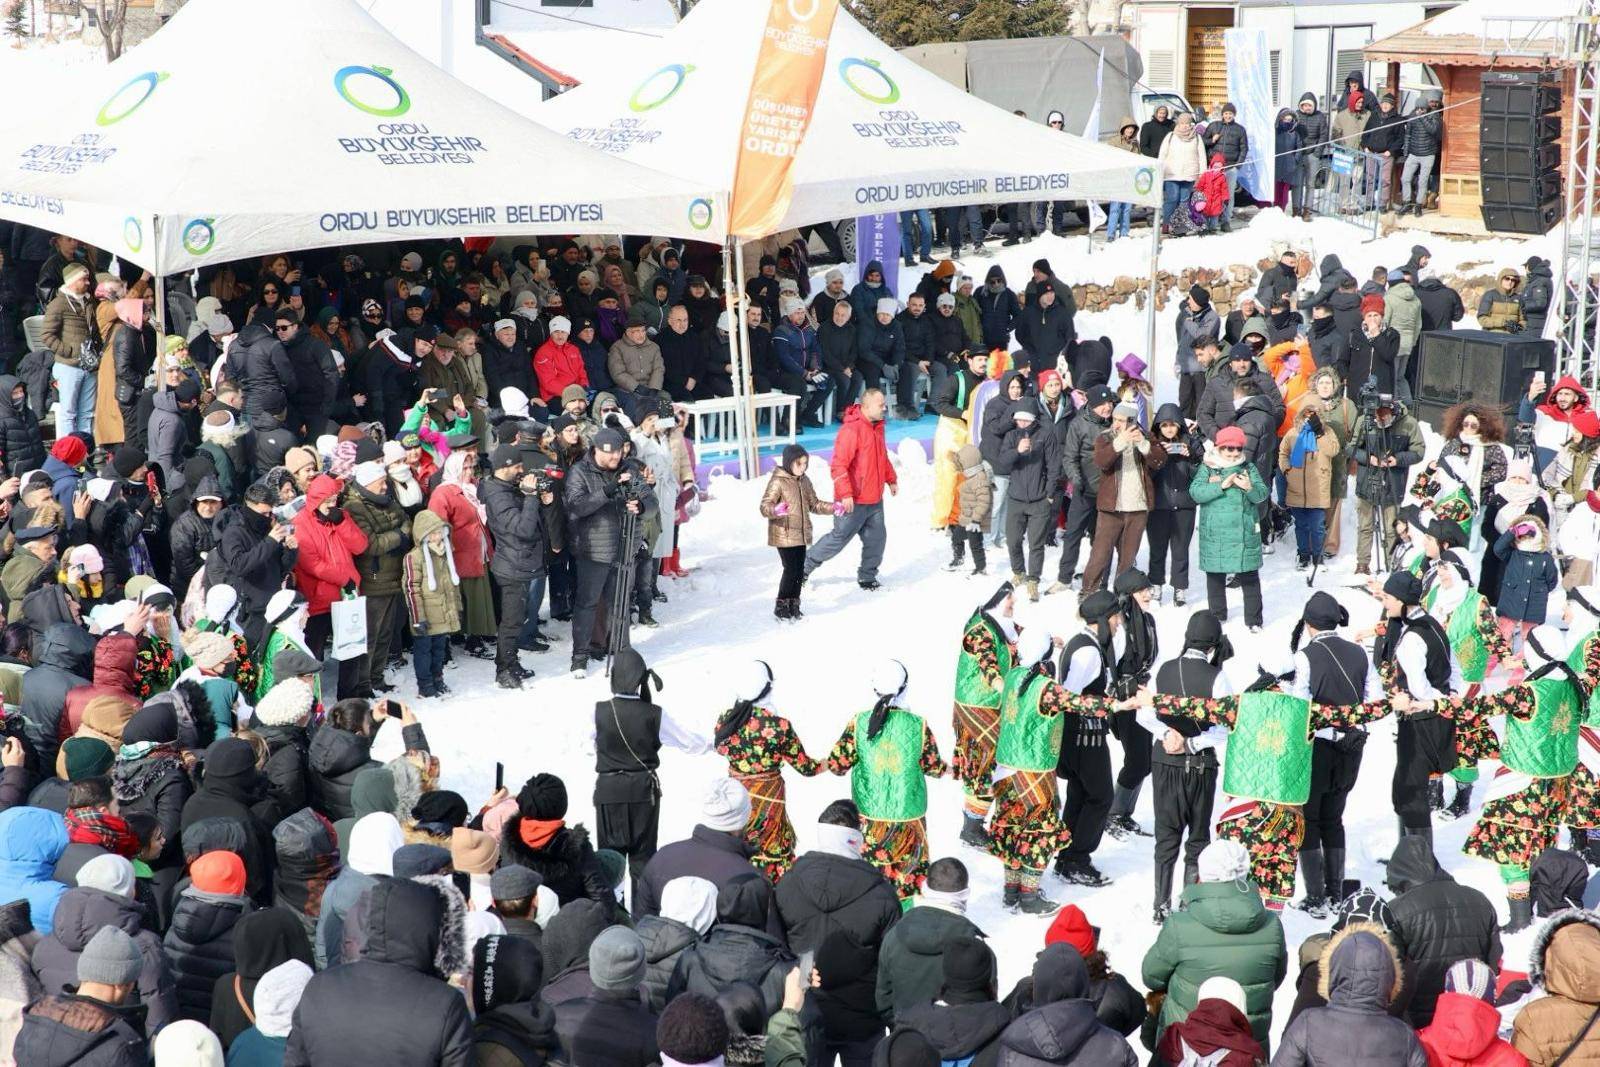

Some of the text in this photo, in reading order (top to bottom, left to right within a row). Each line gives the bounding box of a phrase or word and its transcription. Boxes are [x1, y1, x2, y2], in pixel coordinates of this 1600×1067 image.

[377, 123, 430, 136] ORDU
[855, 185, 899, 204] ORDU
[320, 211, 378, 232] ORDU
